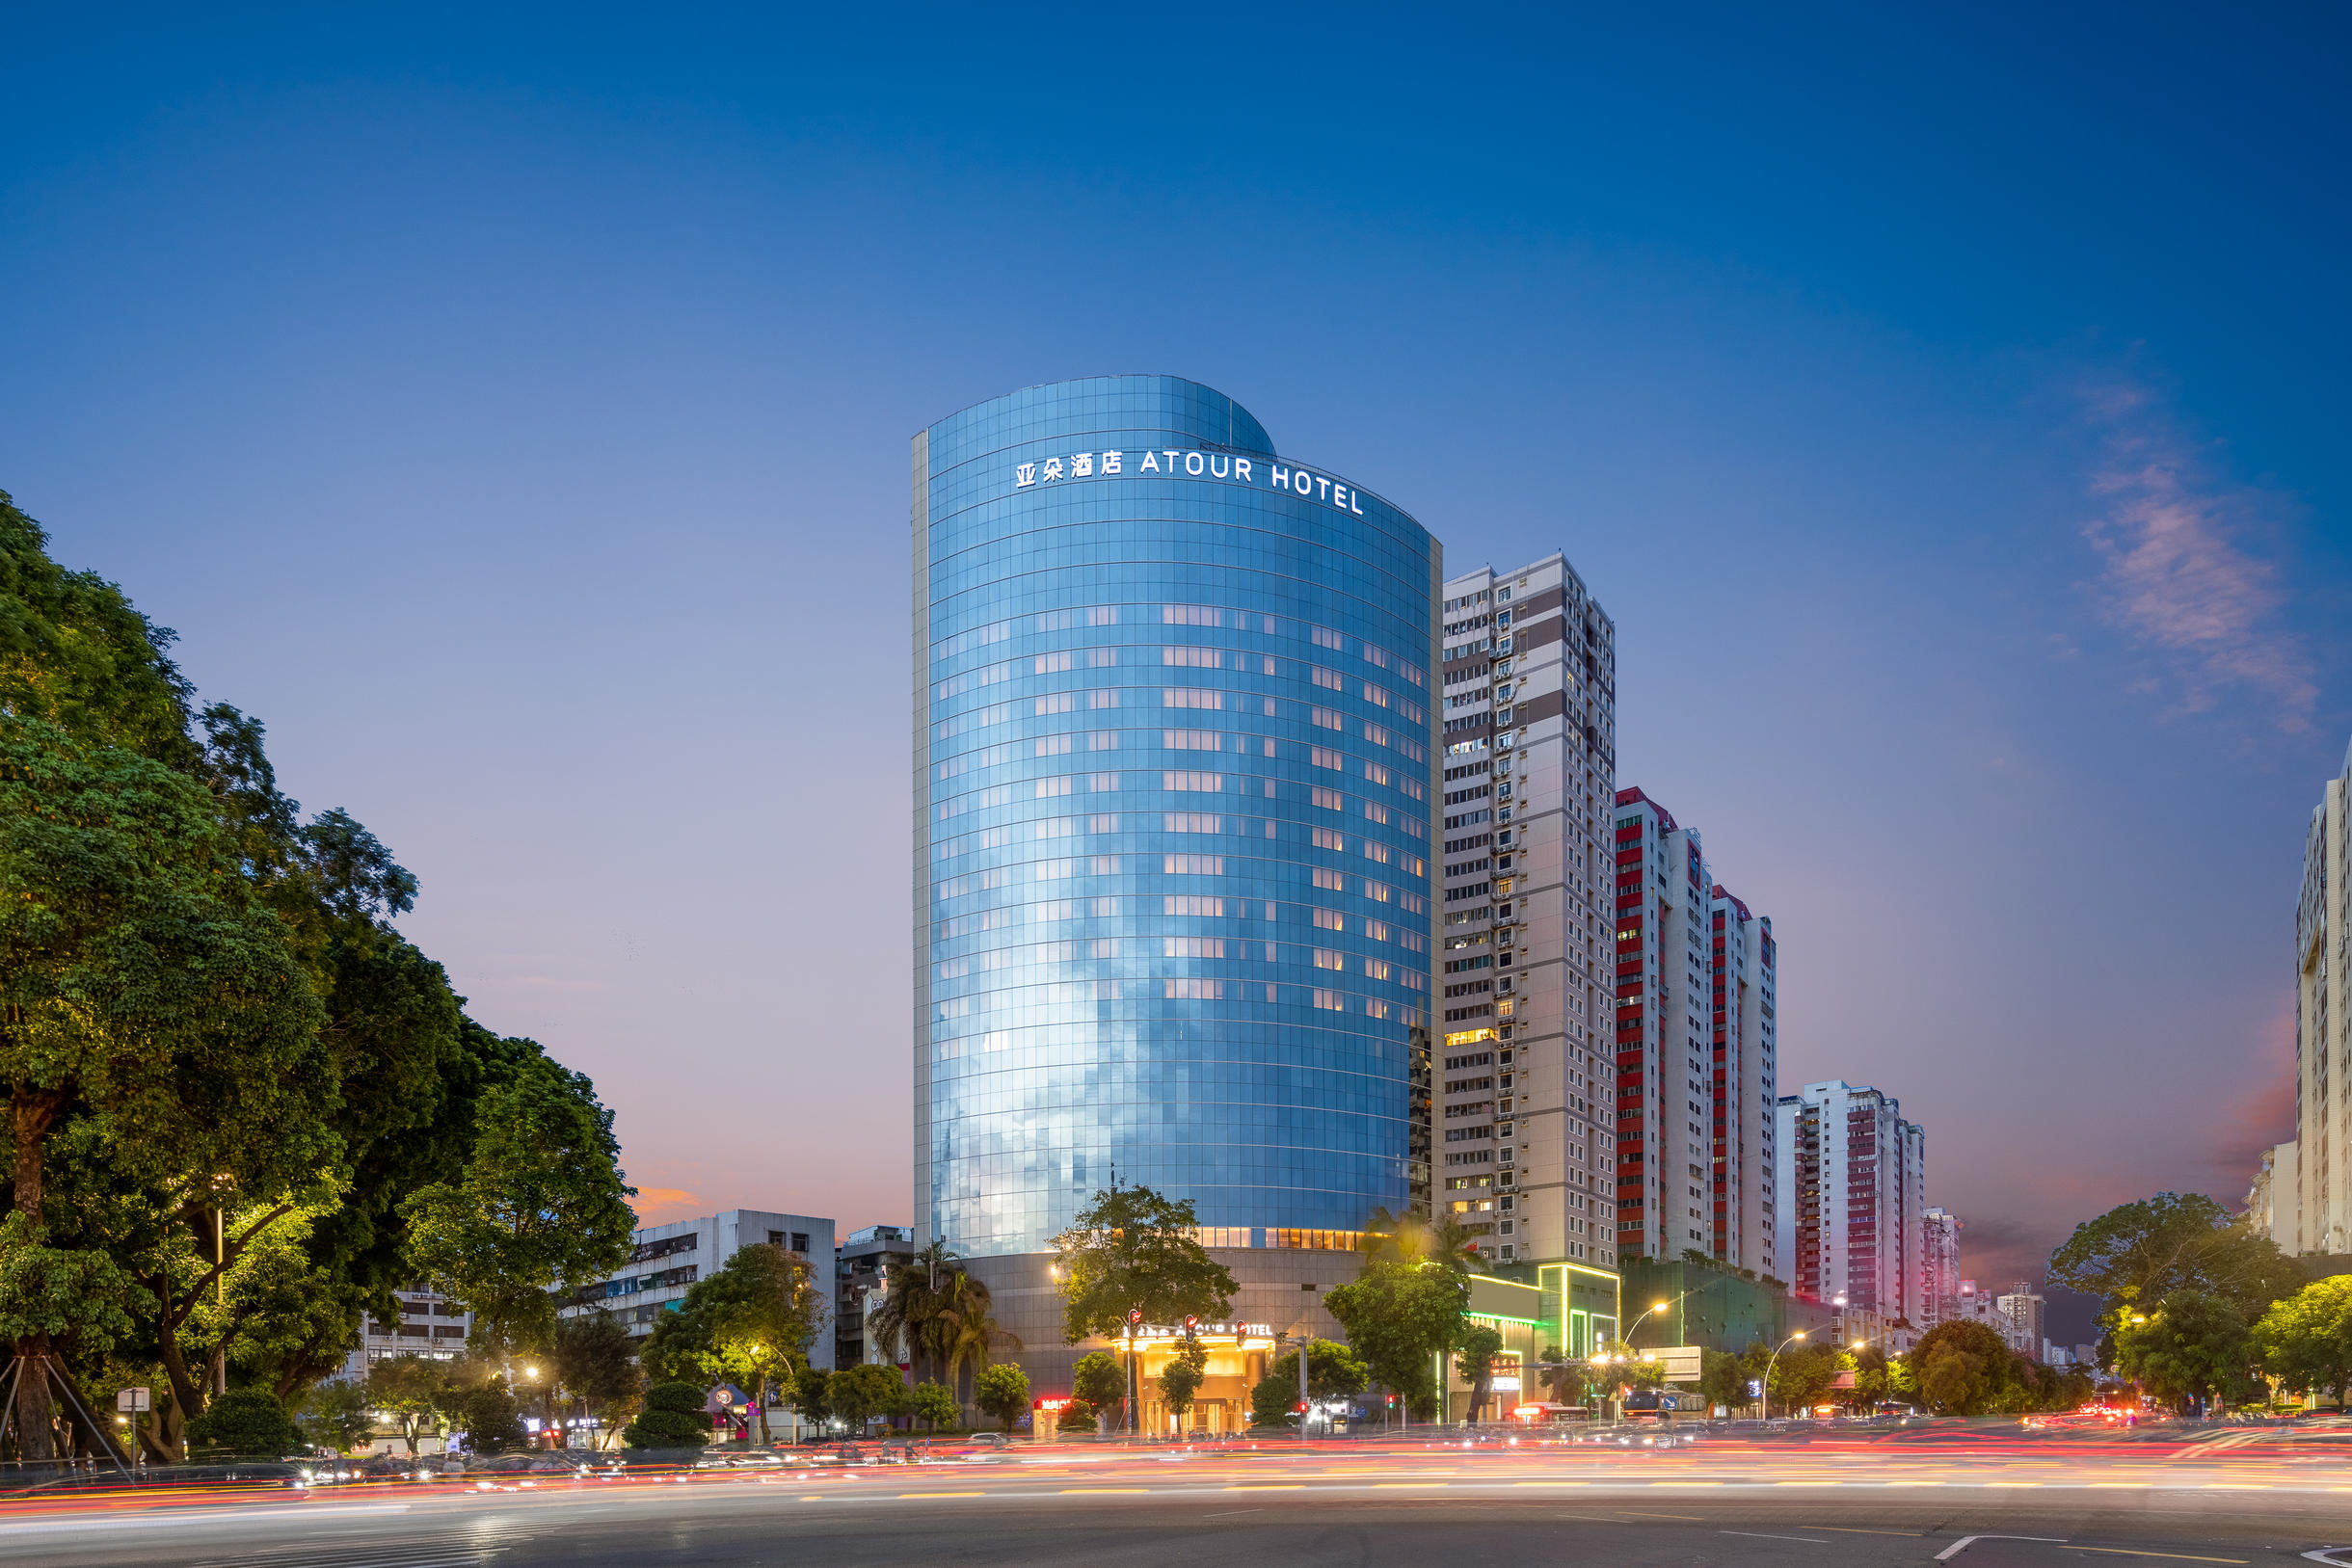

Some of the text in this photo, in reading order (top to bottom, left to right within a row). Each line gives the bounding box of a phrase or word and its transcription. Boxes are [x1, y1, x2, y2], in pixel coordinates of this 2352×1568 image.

[1016, 449, 1364, 516] 亚朵酒店 ATOUR HOTEL
